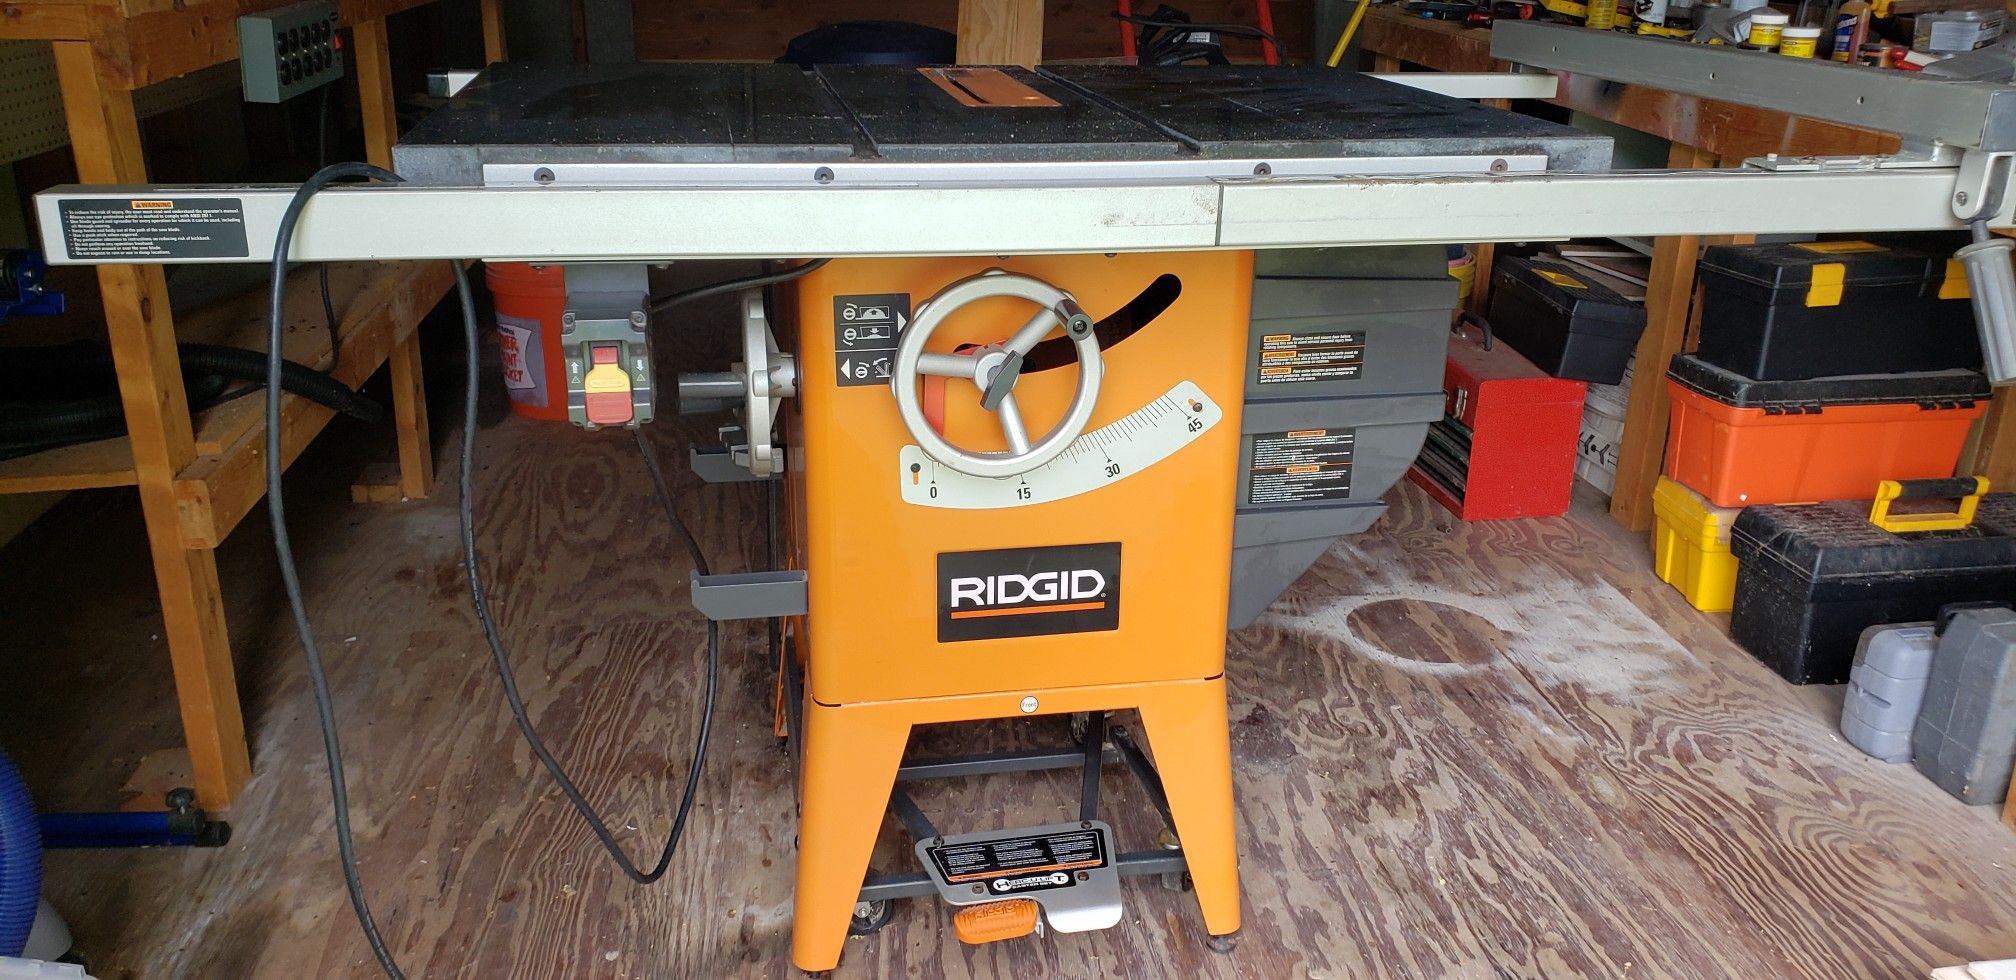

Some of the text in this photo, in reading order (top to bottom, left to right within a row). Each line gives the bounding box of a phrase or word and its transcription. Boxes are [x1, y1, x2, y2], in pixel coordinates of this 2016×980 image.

[1187, 418, 1204, 434] 45
[1105, 463, 1121, 478] 30
[929, 486, 938, 499] 0
[1016, 487, 1031, 500] 15
[951, 569, 1105, 607] RIDGID
